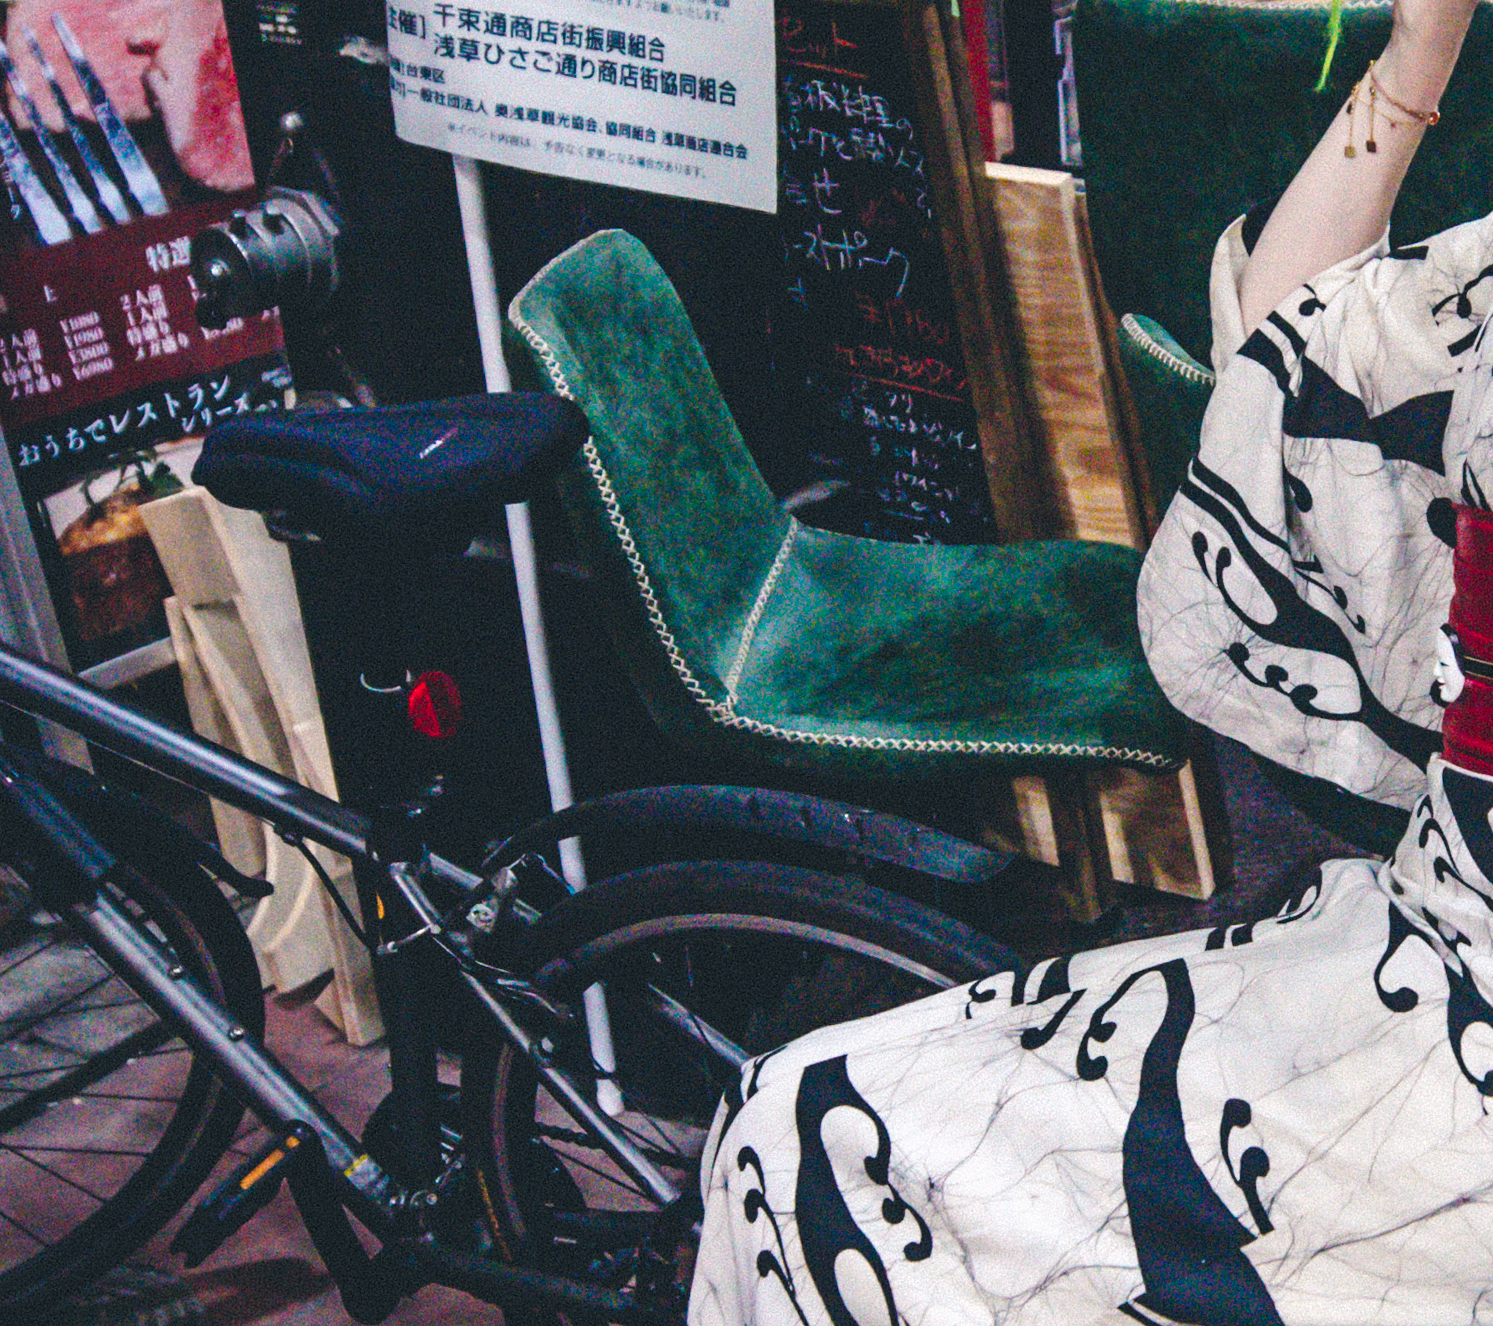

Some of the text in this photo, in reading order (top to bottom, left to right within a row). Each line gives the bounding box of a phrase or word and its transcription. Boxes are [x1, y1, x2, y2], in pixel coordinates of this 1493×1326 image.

[432, 33, 738, 107] 浅草ひさご通り商店街協同組合
[17, 374, 230, 468] おうちでレストラン
